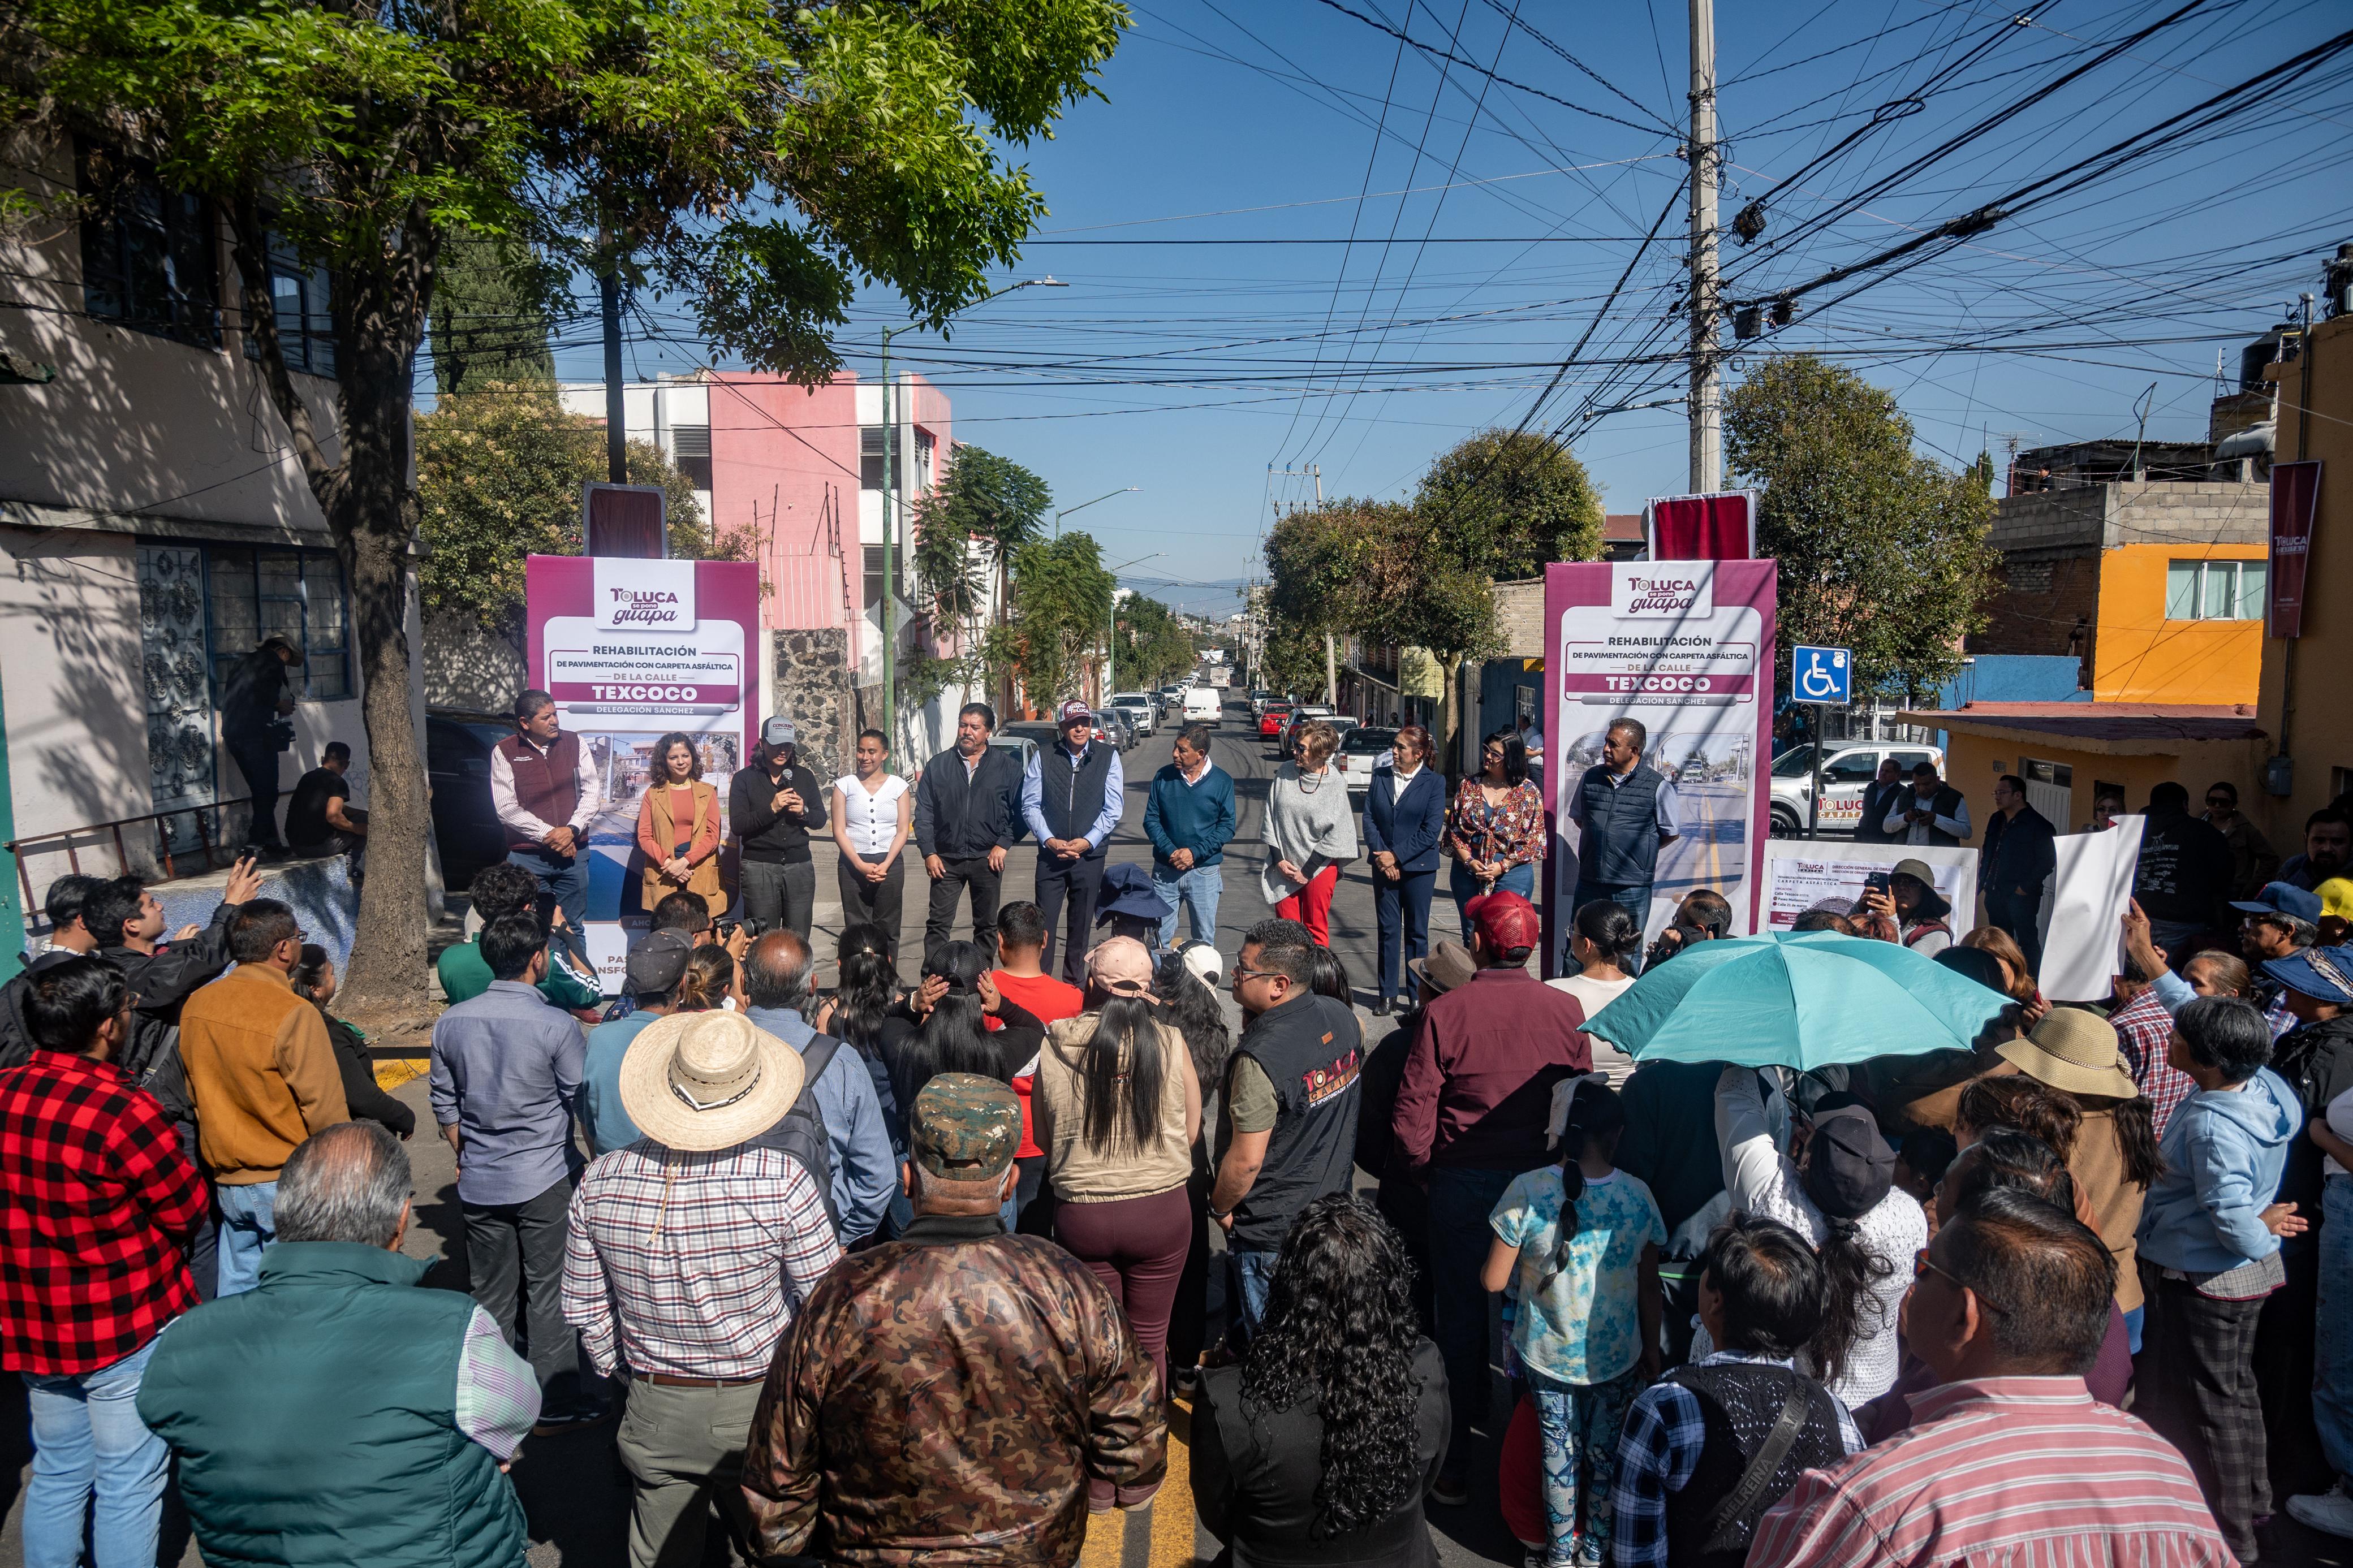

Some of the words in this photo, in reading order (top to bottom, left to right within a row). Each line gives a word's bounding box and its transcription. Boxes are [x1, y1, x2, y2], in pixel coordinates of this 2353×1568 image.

[2274, 535, 2307, 547] TOLUCA
[1628, 577, 1696, 591] TOLUCA
[610, 588, 678, 603] TOLUCA
[1628, 598, 1695, 614] guapa
[612, 610, 678, 625] guapa
[1608, 635, 1712, 646] REHABILITACIÓN
[593, 645, 696, 656] REHABILITACIÓN
[1705, 651, 1748, 660] ASFÁLTICA
[692, 662, 733, 671] ASFÁLTICA
[1606, 676, 1711, 691] TEXCOCO
[592, 685, 697, 701] TEXCOCO
[1610, 696, 1664, 705] DELEGACIÓN
[1666, 696, 1706, 705] SÁNCHEZ
[597, 705, 652, 714] DELEGACIÓN
[654, 706, 694, 714] SÁNCHEZ
[1819, 798, 1863, 811] TOLUC
[1303, 1049, 1359, 1092] TOLUCA
[1716, 1458, 1774, 1530] AMELREINA
